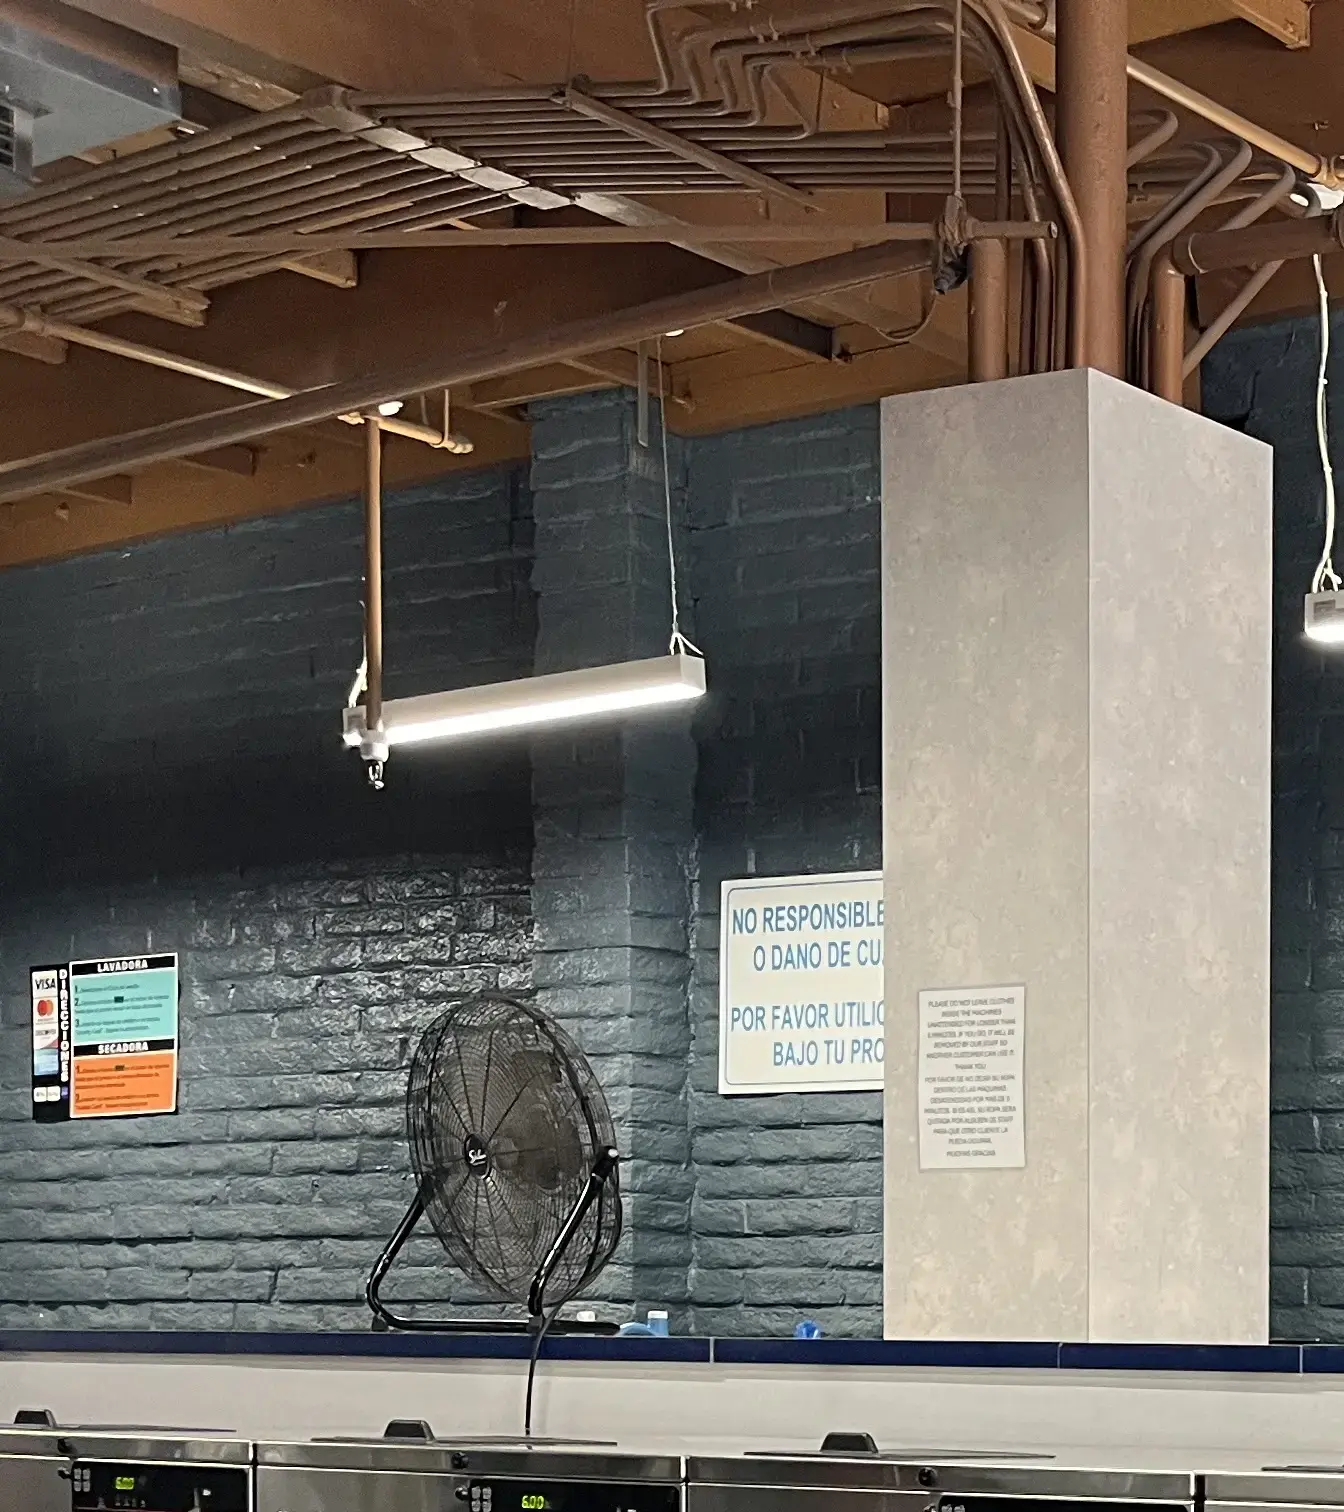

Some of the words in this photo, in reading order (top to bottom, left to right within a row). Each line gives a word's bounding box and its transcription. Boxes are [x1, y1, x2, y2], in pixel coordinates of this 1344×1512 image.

[732, 908, 757, 935] NO
[97, 959, 148, 973] LAVADORA
[753, 945, 766, 972] O
[771, 942, 822, 971] DANO
[827, 940, 851, 968] DE
[857, 939, 884, 966] CU
[34, 978, 57, 991] VISA
[731, 1005, 766, 1032] POR
[771, 1002, 829, 1031] FAVOR
[98, 1042, 149, 1055] SECADORA
[772, 1039, 819, 1067] BAJO
[824, 1039, 845, 1065] TU
